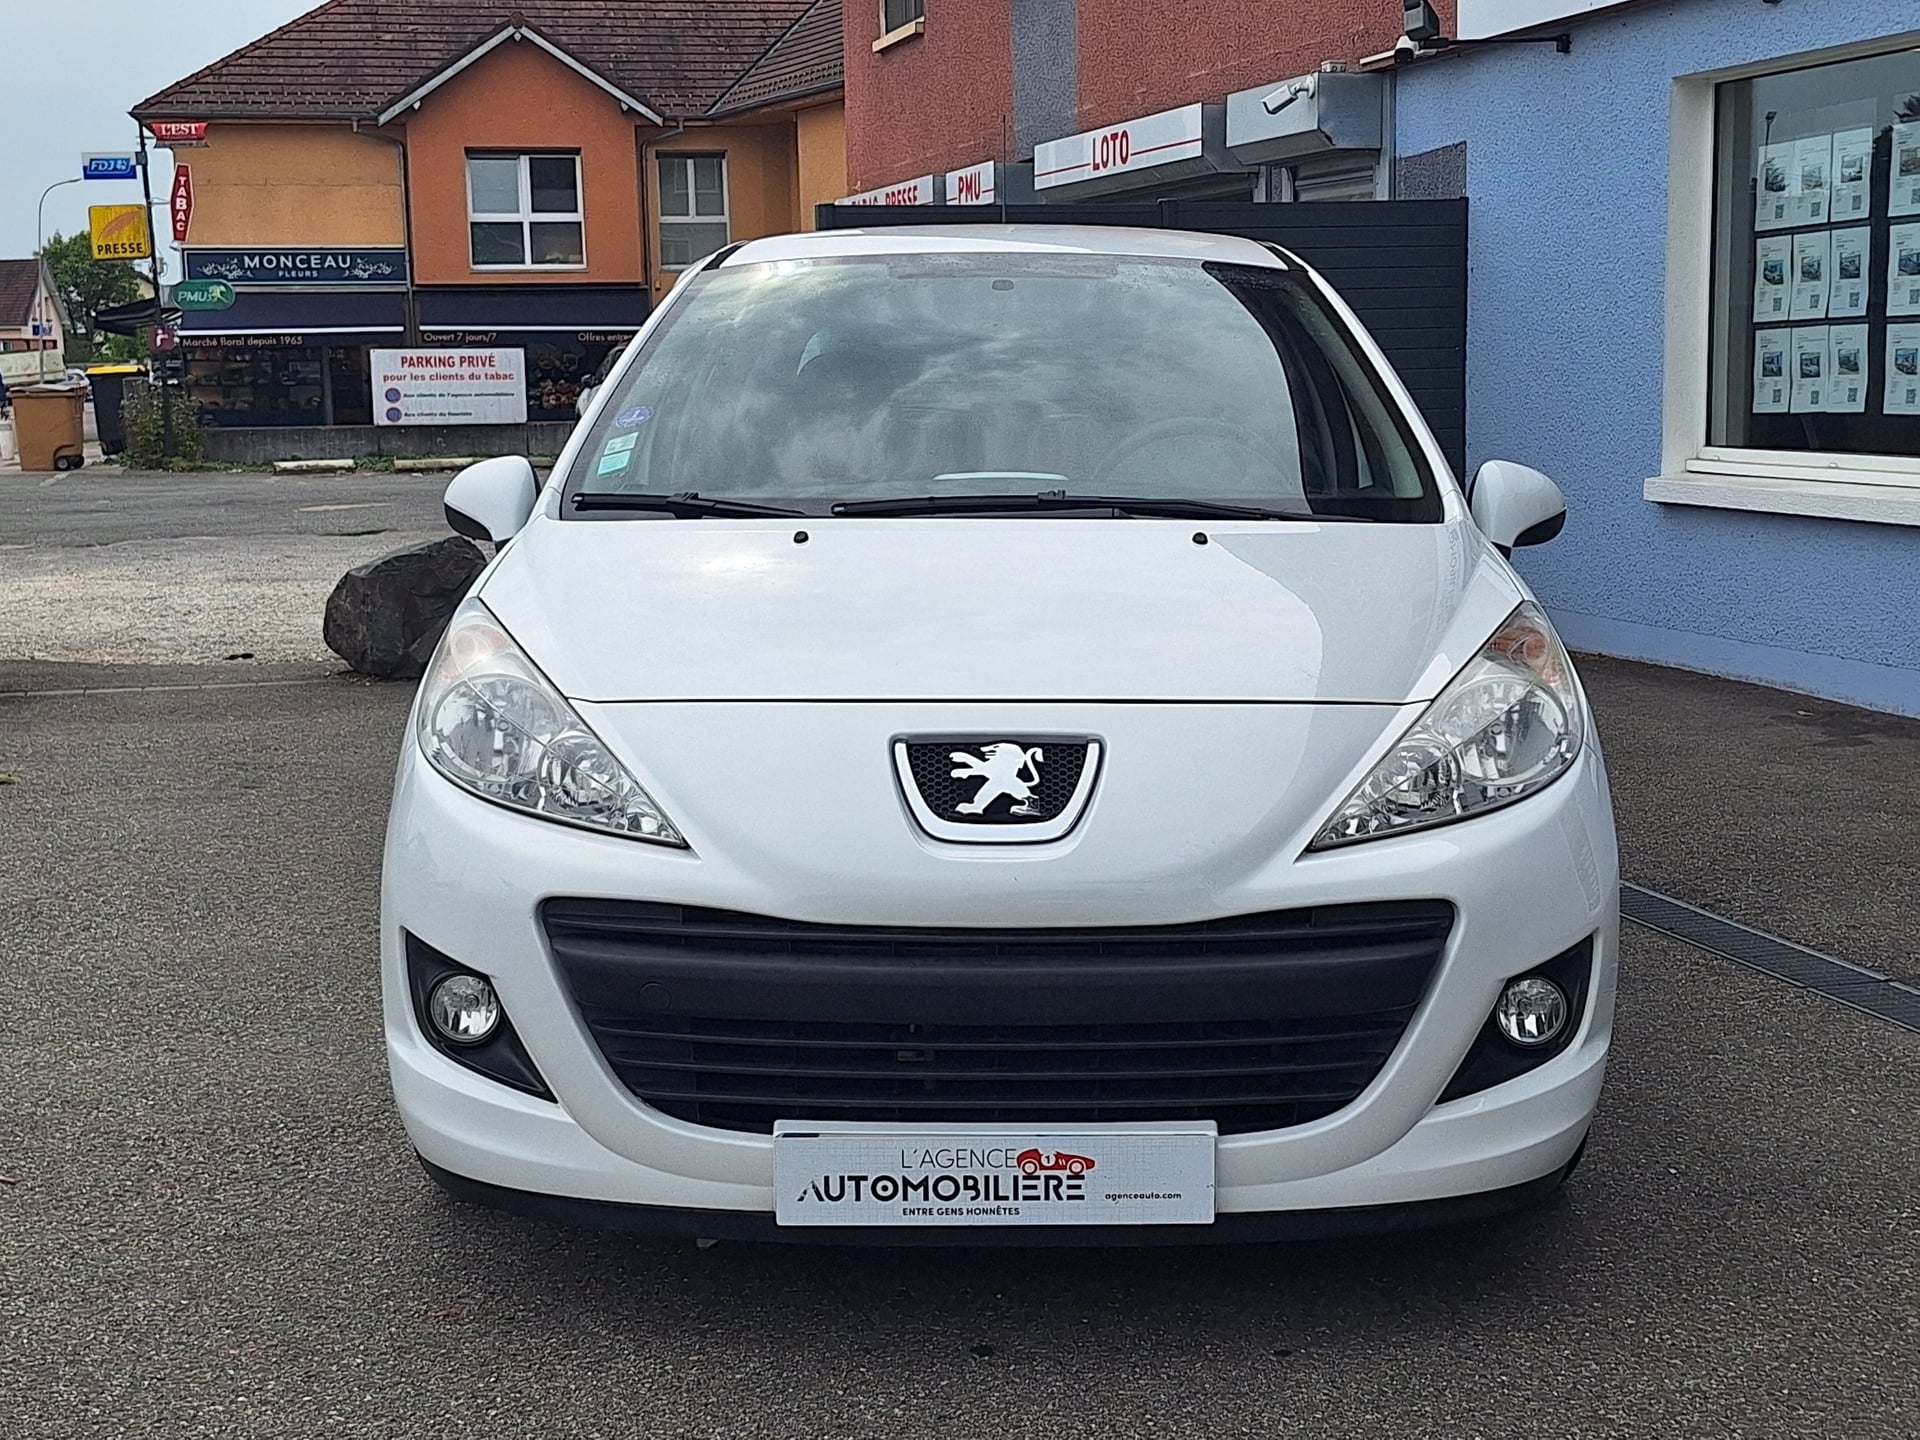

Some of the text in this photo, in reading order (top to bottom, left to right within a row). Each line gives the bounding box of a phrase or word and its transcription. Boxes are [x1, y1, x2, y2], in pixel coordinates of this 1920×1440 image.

[1092, 129, 1129, 171] LOTO
[91, 160, 115, 171] FDJ
[957, 171, 981, 204] PMU
[175, 177, 188, 231] TABAC
[97, 242, 143, 255] PRESSE
[244, 254, 351, 269] MONCEAU
[278, 270, 319, 278] FLEURS
[177, 290, 208, 303] PMU
[182, 336, 218, 347] Marché
[220, 336, 245, 346] floral
[247, 335, 277, 347] depuis
[423, 332, 455, 342] Ouvert
[456, 332, 463, 341] 7
[577, 332, 605, 342] Offres
[400, 352, 496, 368] PARKING PRIVÉ
[383, 371, 515, 383] pour les clients du tabac
[901, 1148, 1017, 1169] L'AGENCE
[1105, 1191, 1182, 1201] agenceauto.com
[902, 1204, 1020, 1216] ENTRE GENS HONNÊTES
